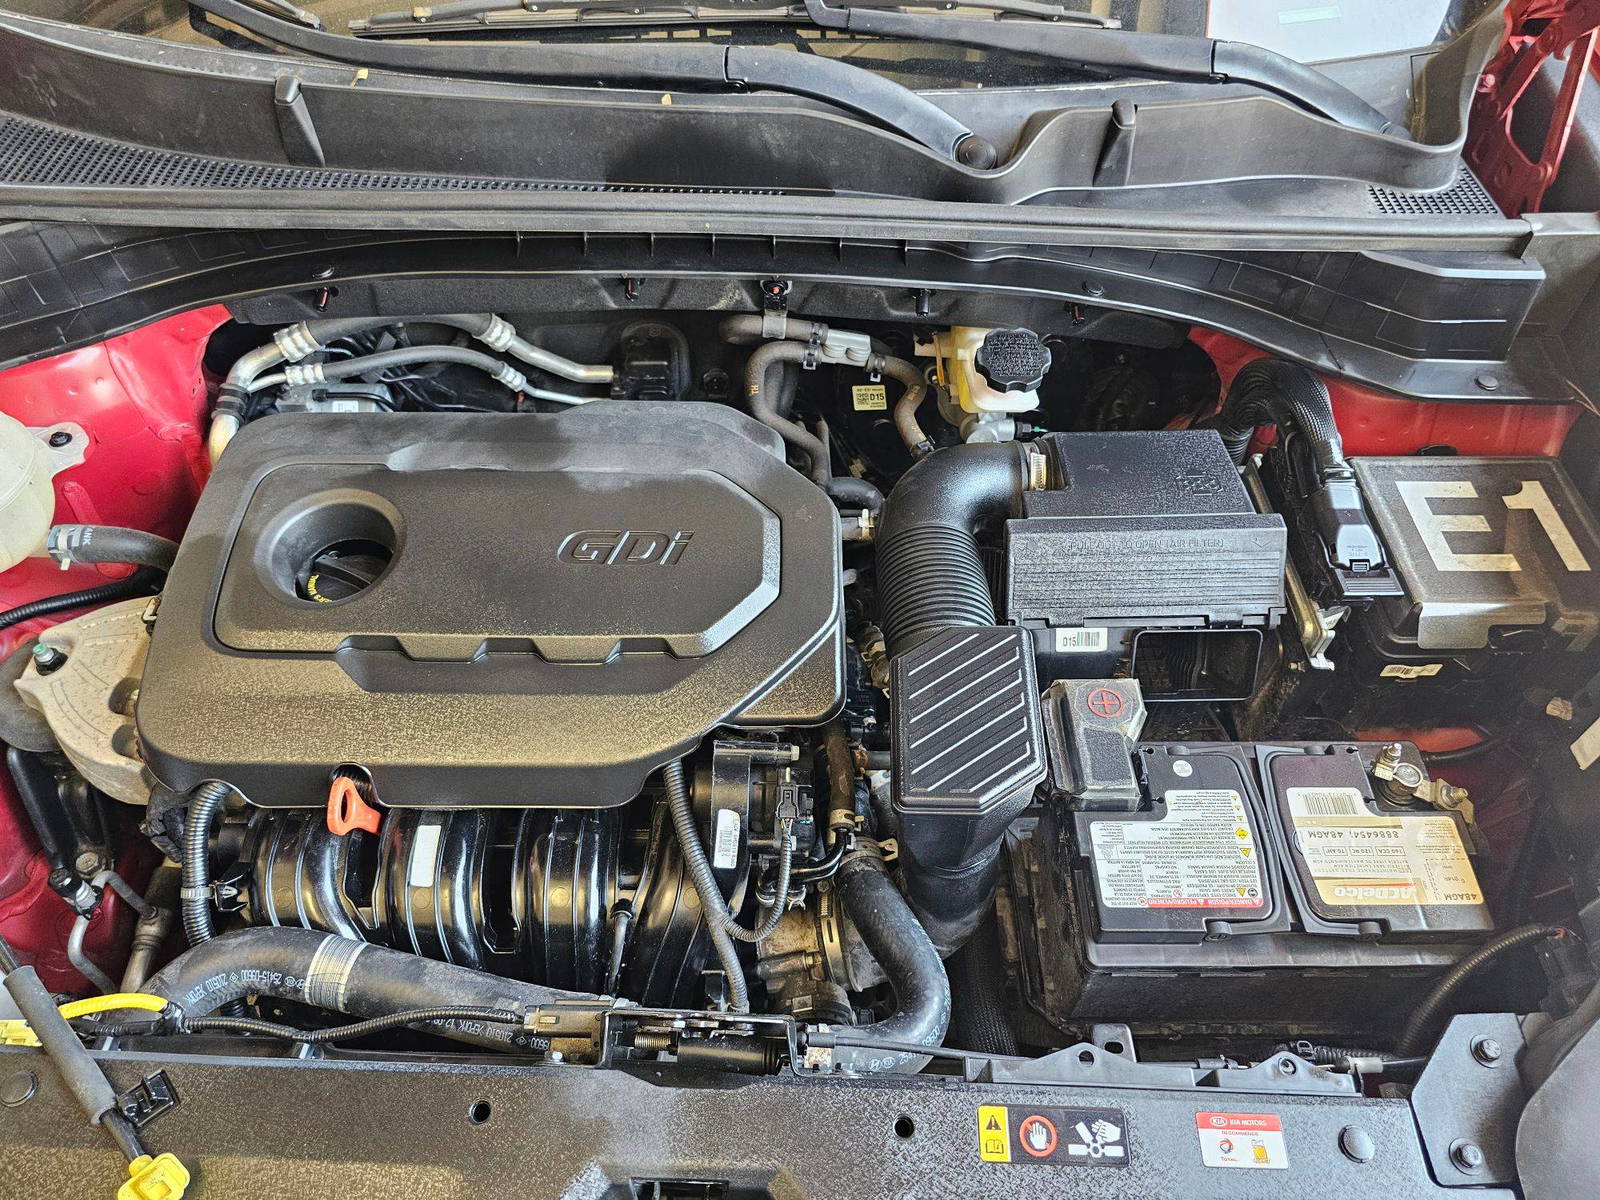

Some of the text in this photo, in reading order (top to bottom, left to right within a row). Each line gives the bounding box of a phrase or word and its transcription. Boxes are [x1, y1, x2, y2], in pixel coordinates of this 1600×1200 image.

[870, 393, 885, 401] D15
[1395, 481, 1591, 571] E1
[557, 530, 695, 564] GDi
[1308, 831, 1344, 839] 48AGM
[1444, 893, 1477, 901] 48AGM
